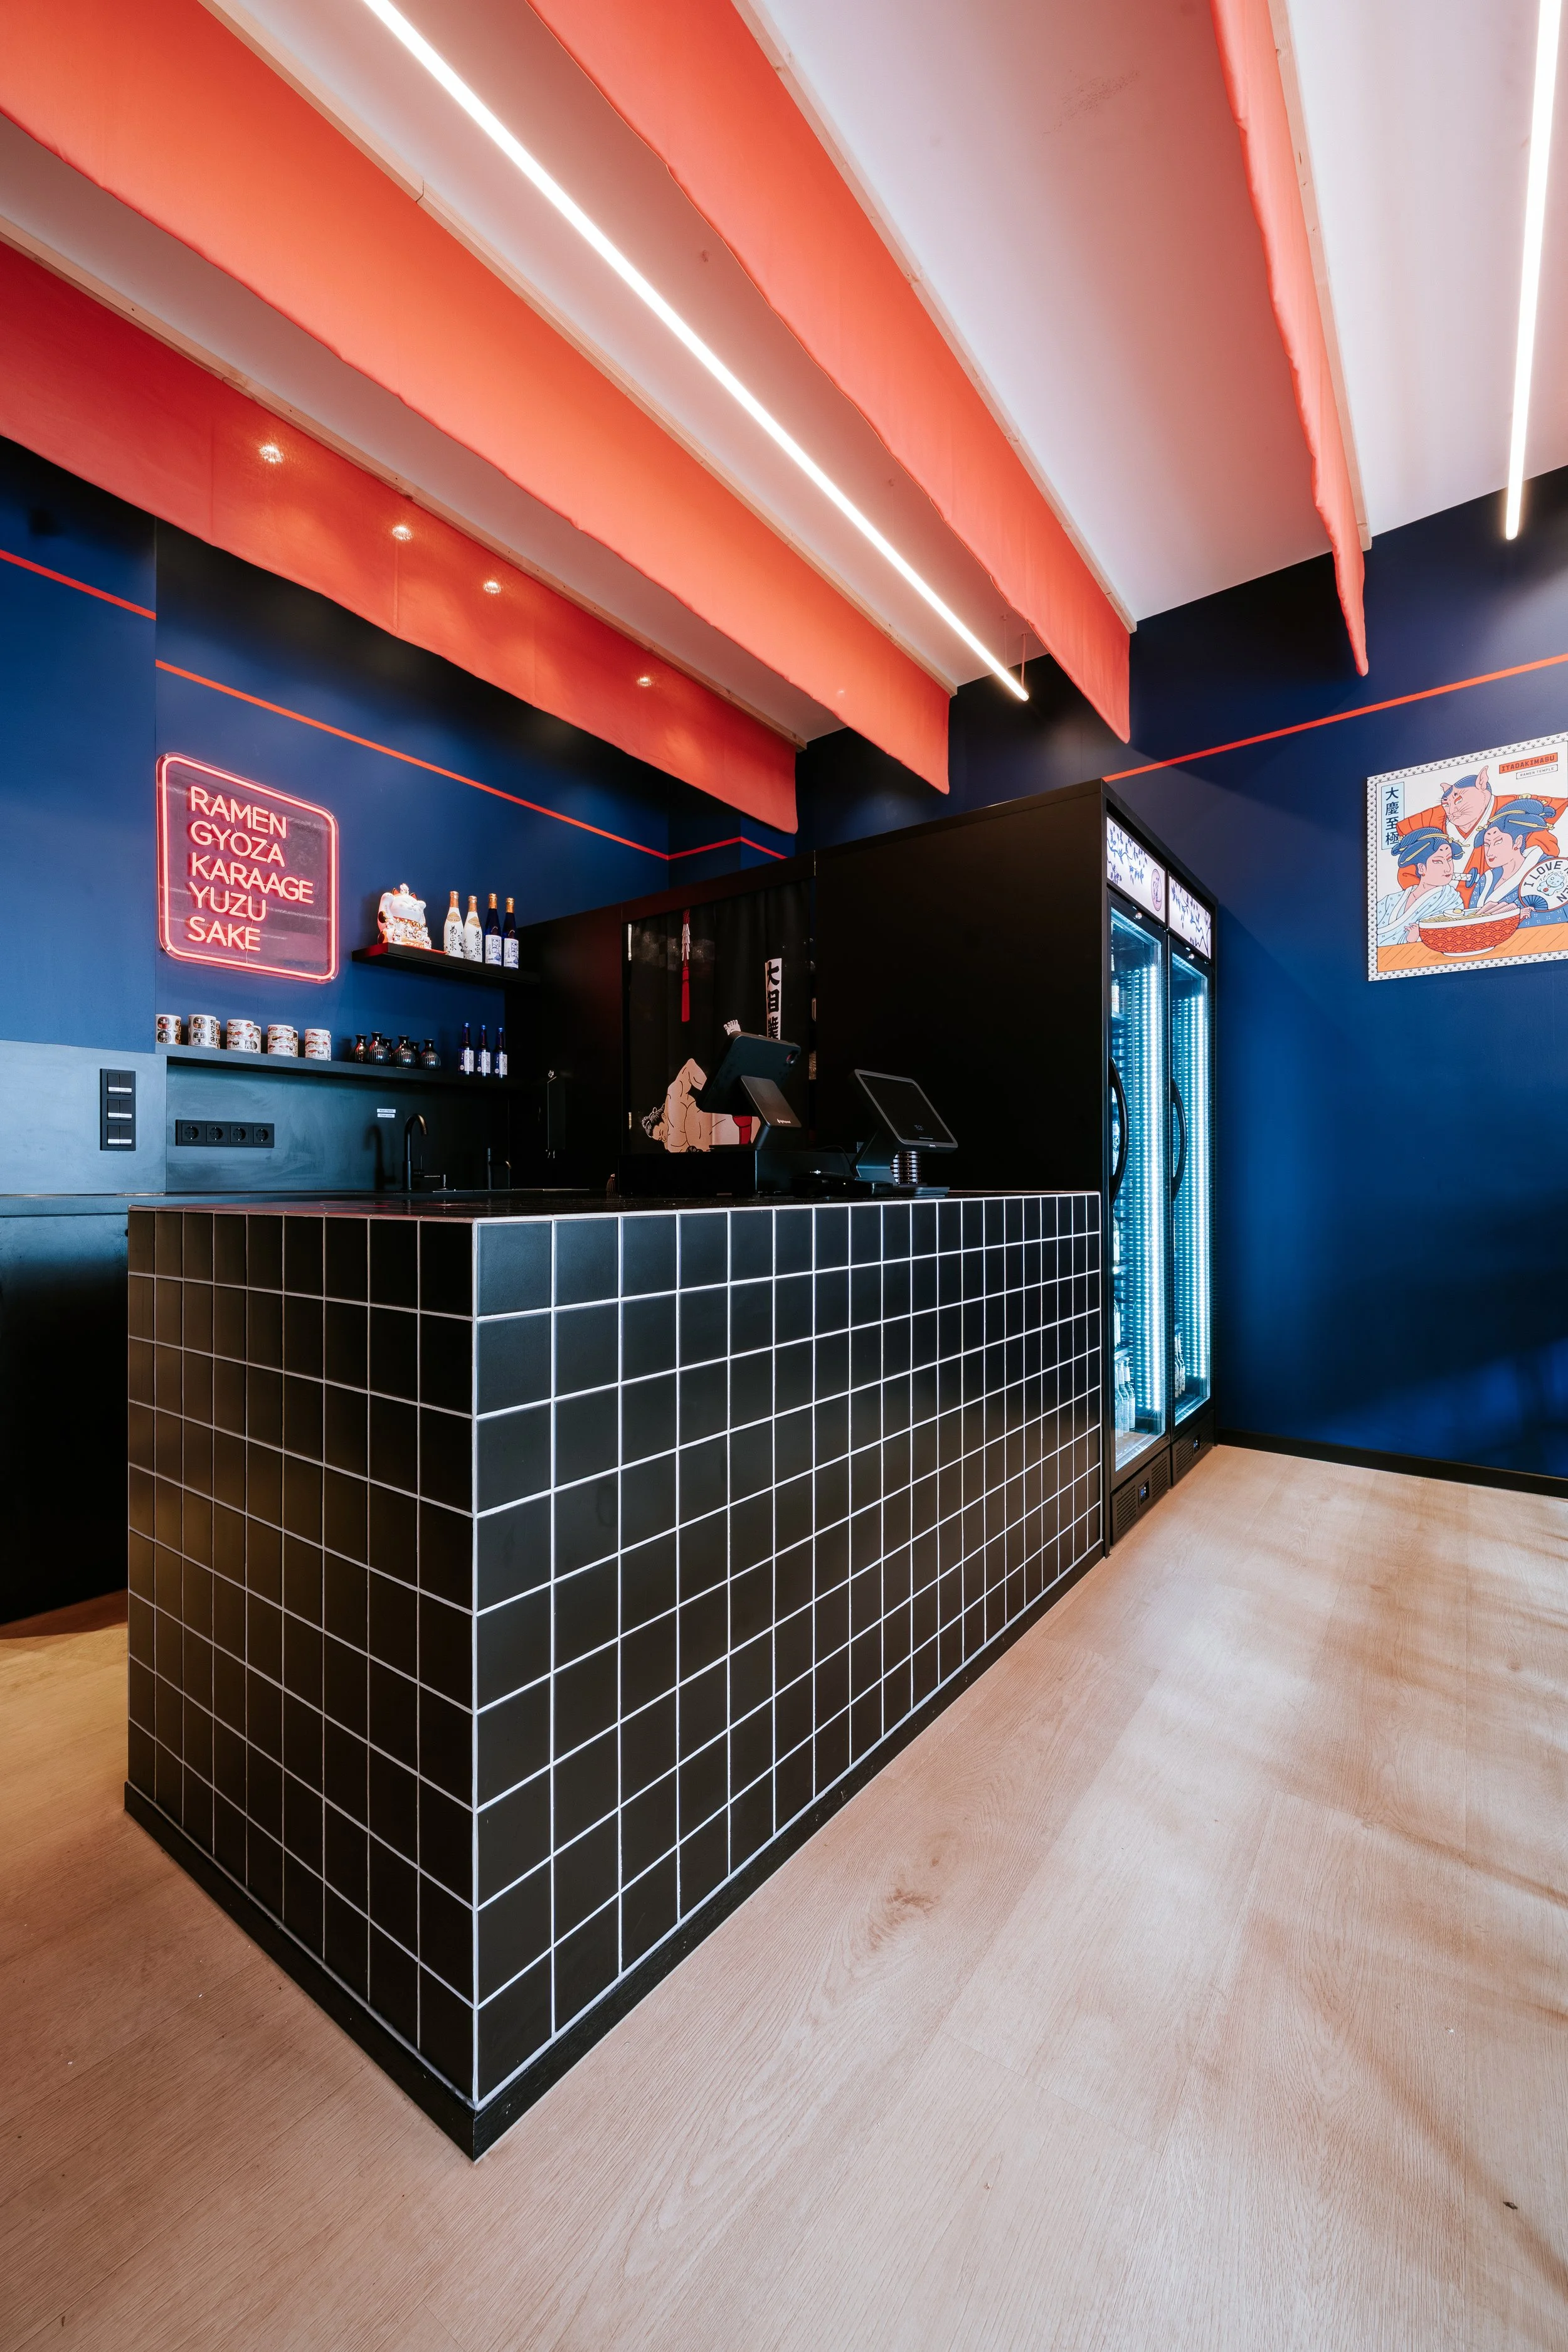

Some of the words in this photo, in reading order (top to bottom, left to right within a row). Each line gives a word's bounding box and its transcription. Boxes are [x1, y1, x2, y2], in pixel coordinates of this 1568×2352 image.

[1501, 755, 1555, 771] ITADAKIMASU
[190, 785, 287, 839] RAMEN
[190, 820, 285, 867] GYOZA
[191, 852, 314, 904] KARAAGE
[1529, 861, 1563, 880] LOVE
[189, 881, 267, 921] YUZU
[188, 916, 261, 951] SAKE
